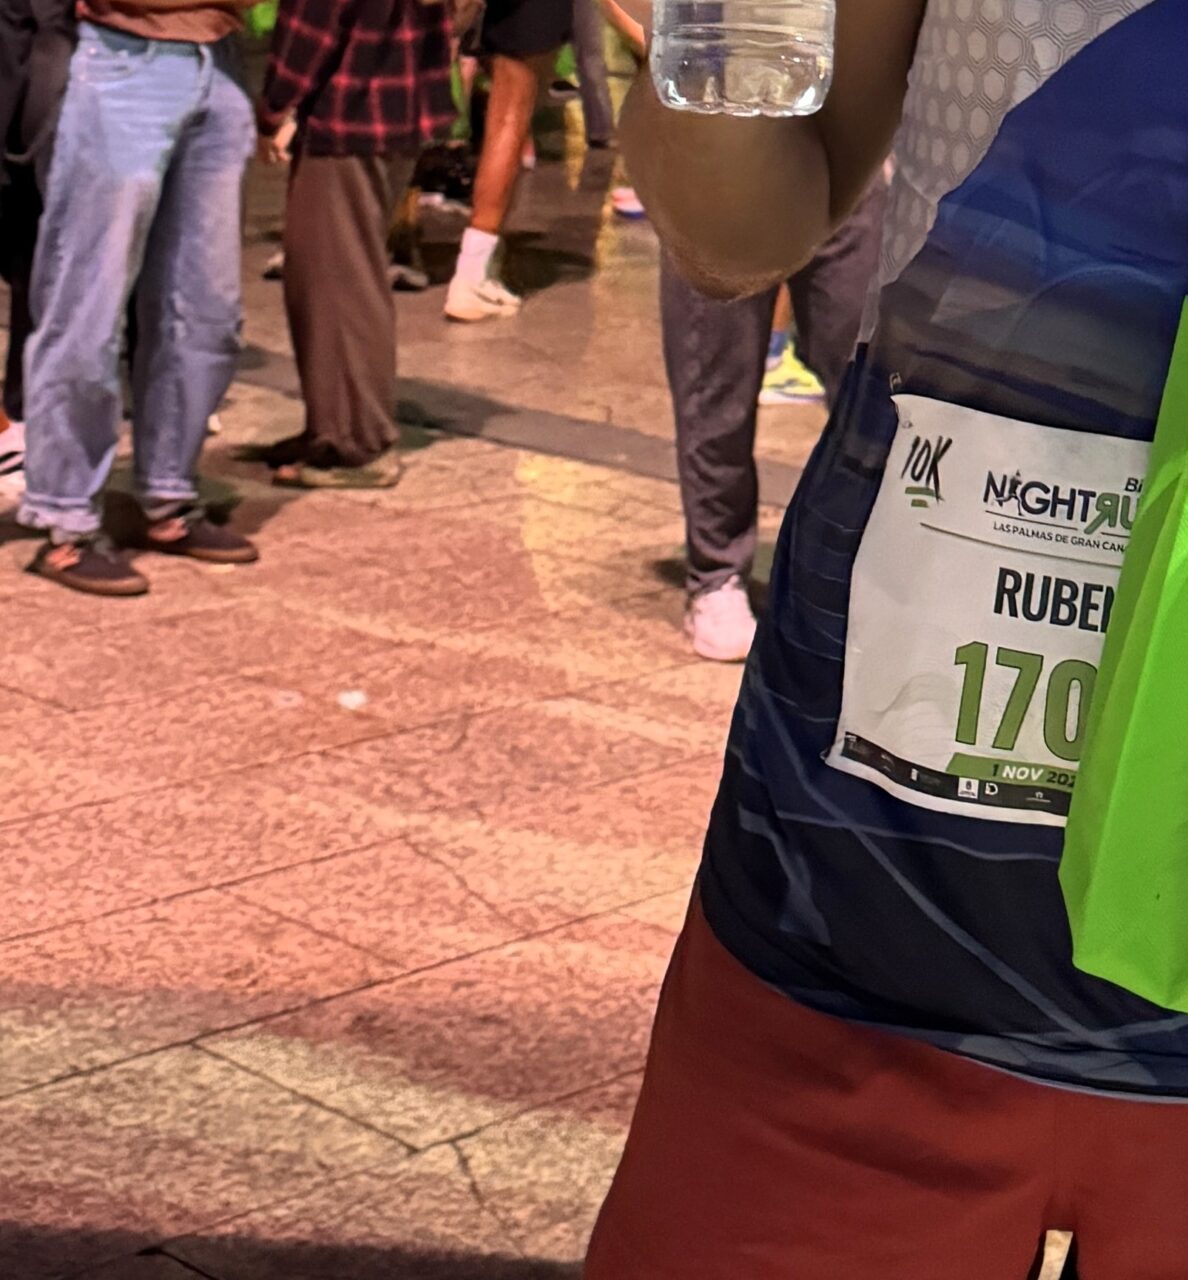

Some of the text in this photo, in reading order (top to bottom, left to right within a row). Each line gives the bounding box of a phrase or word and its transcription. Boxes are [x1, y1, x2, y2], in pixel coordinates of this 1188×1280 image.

[901, 435, 953, 504] 10K
[993, 521, 1012, 533] LAS
[1012, 524, 1053, 542] PALMAS
[1055, 533, 1068, 544] DE
[1070, 536, 1101, 550] GRAN
[992, 764, 1000, 777] 1
[1002, 765, 1044, 781] NOV
